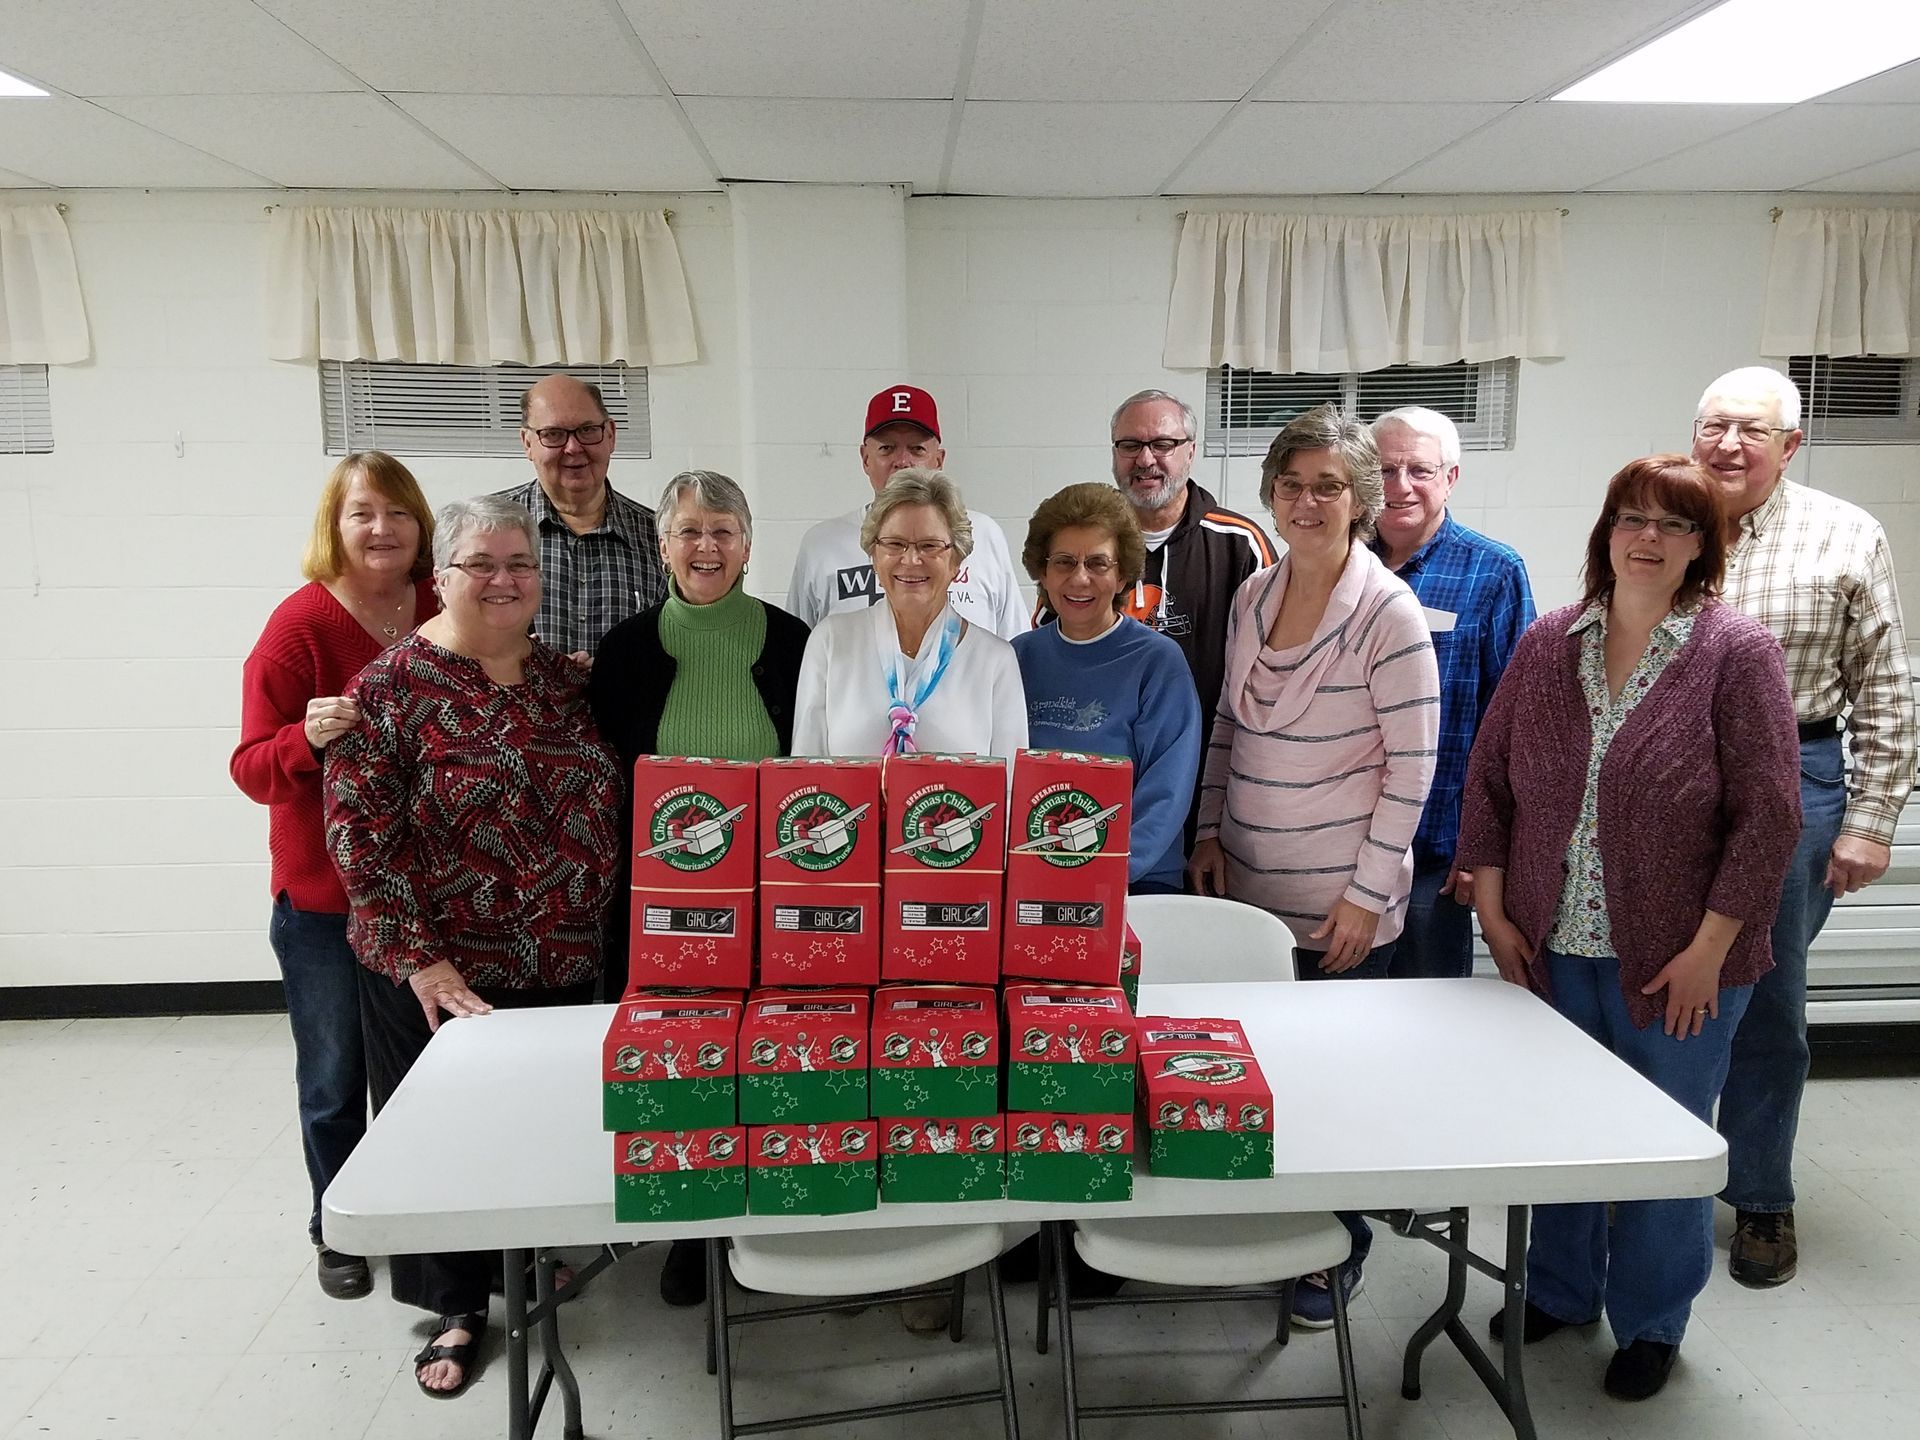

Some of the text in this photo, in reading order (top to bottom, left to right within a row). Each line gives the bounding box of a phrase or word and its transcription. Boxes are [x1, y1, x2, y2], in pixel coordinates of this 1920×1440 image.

[892, 392, 911, 412] E
[957, 591, 974, 604] VA.
[653, 785, 694, 808] OPERATION
[779, 785, 818, 810] OPERATION
[905, 783, 945, 807] OPERATION
[1030, 782, 1071, 805] OPERATION
[653, 795, 722, 841] Christmas Child
[780, 794, 846, 842] Christmas Child
[905, 793, 972, 839] Christmas Child
[1029, 792, 1097, 837] Christmas Child
[669, 845, 728, 870] Samaritan's Purse
[796, 844, 853, 870] Samaritan's Purse
[920, 843, 977, 867] Samaritan's Purse
[686, 912, 708, 928] GIRL
[814, 911, 836, 927] GIRL
[941, 907, 963, 922] GIRL
[1057, 907, 1079, 922] GIRL
[1065, 996, 1087, 1004] GIRL
[678, 1009, 700, 1017] GIRL
